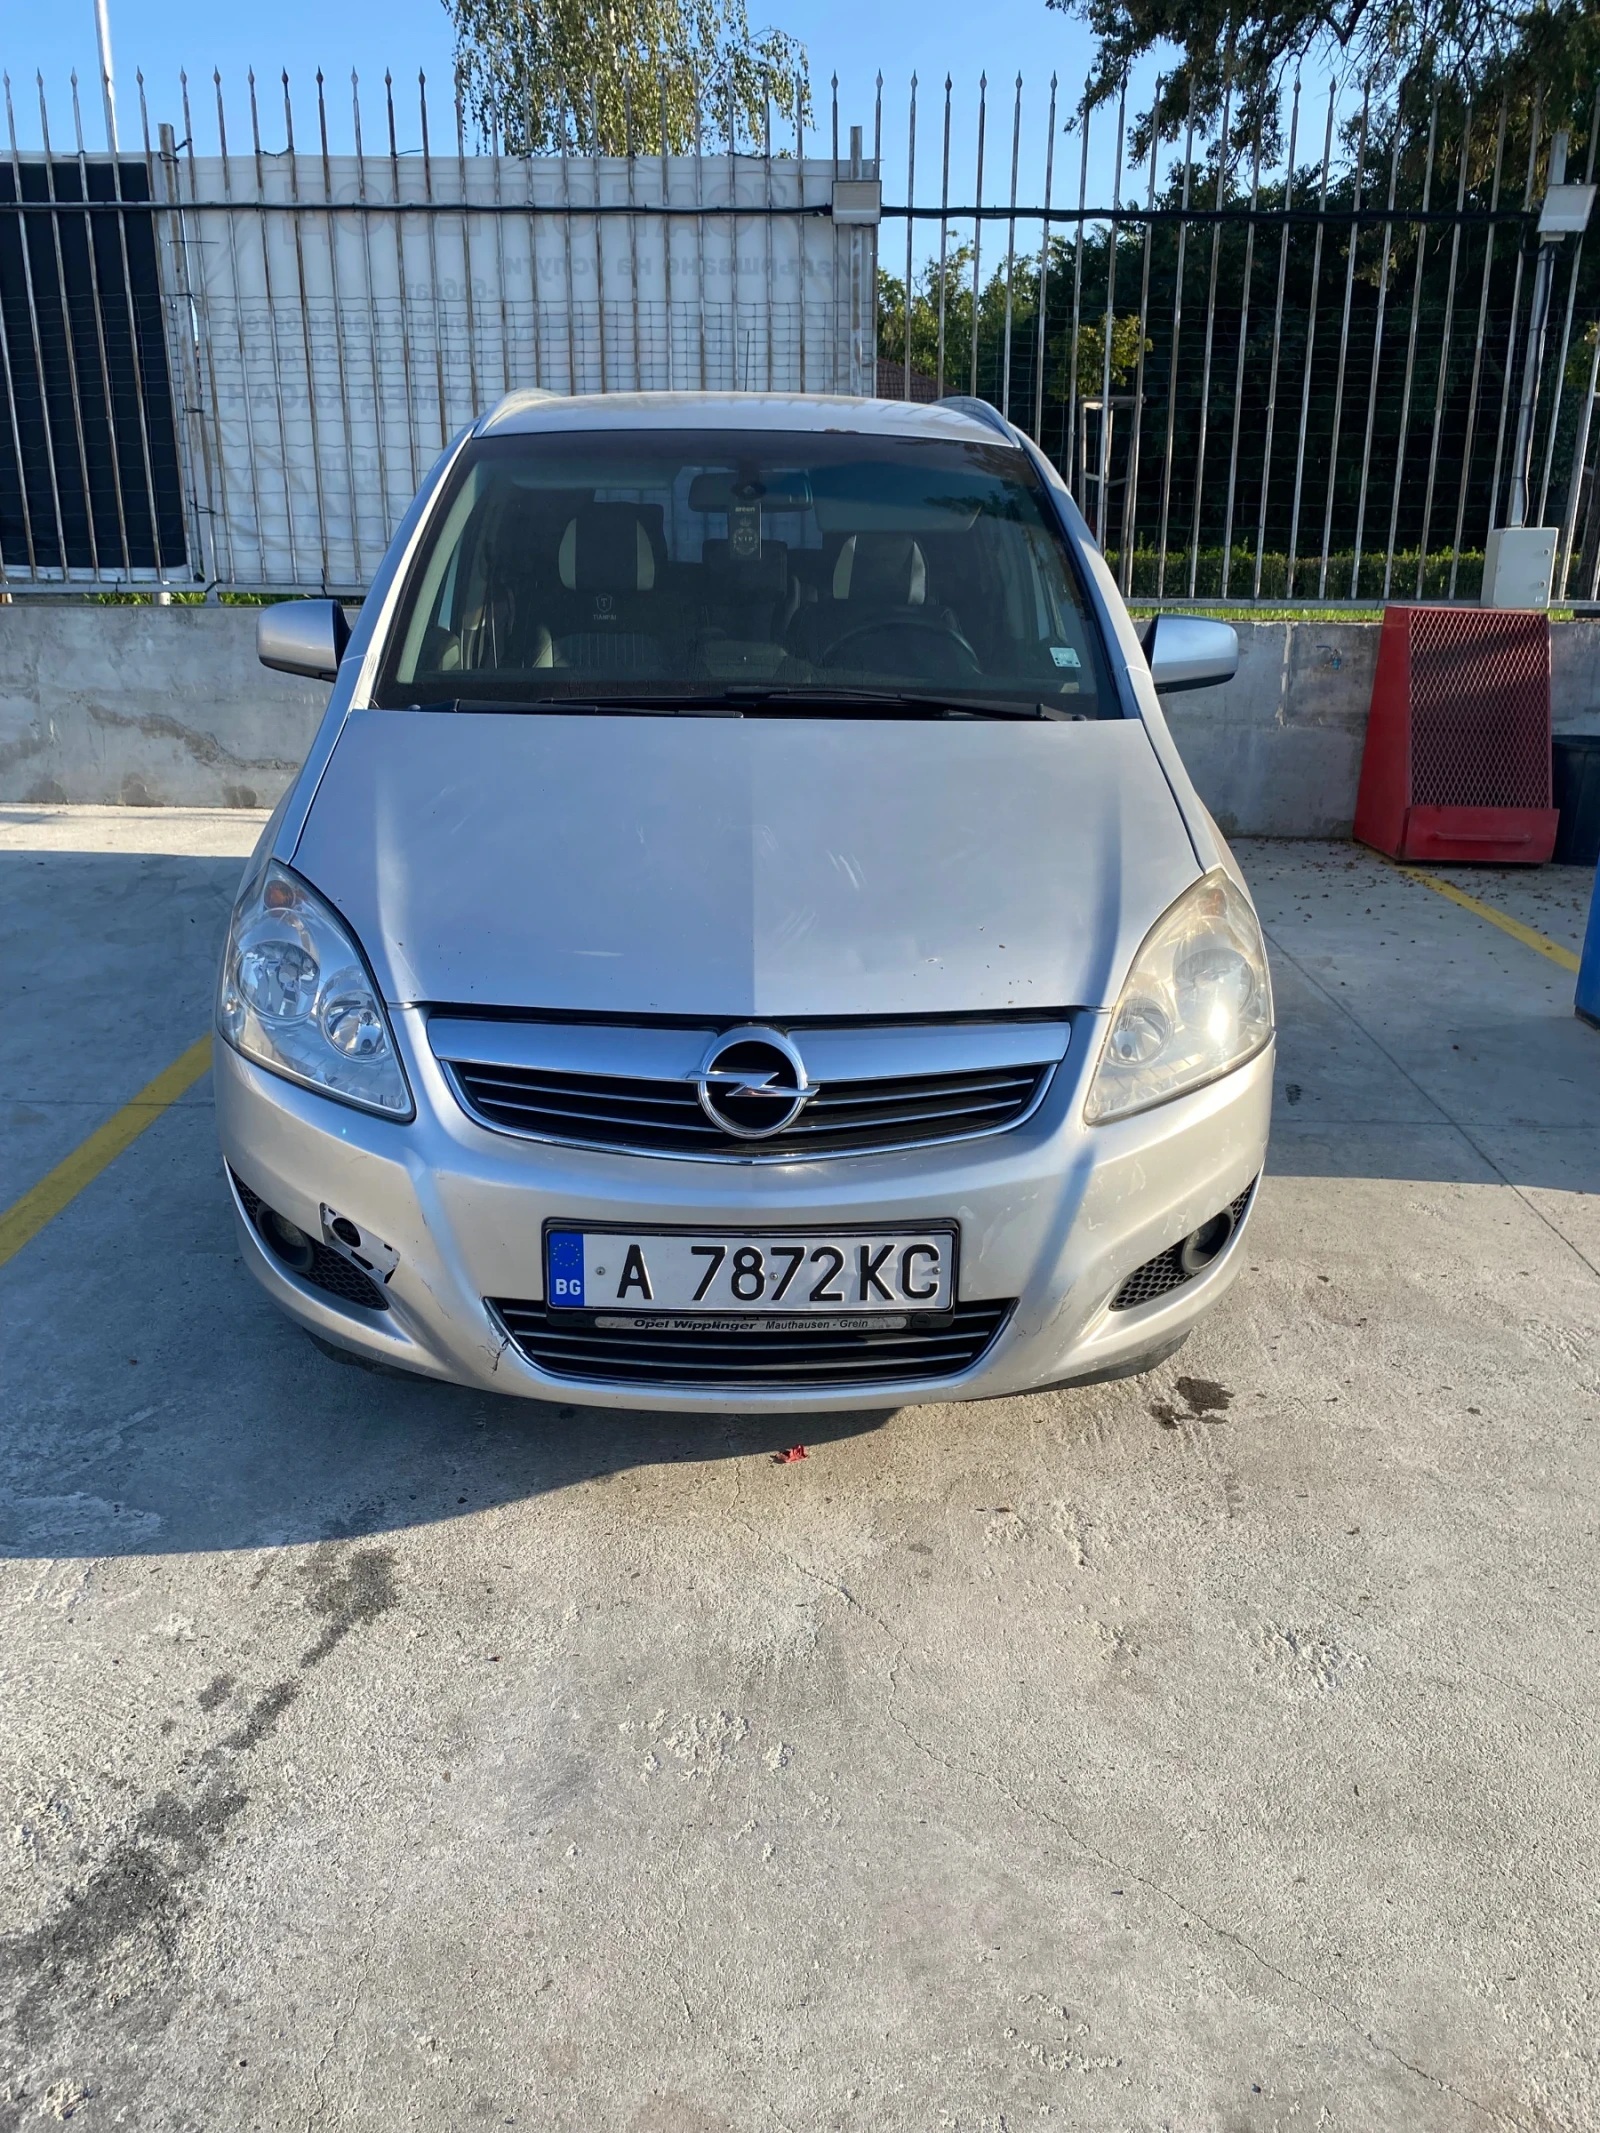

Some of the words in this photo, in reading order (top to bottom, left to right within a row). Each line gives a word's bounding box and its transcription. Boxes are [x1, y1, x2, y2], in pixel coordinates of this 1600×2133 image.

[556, 1278, 582, 1296] BG
[633, 1317, 670, 1330] Opel
[674, 1319, 757, 1332] Wipplinger
[765, 1319, 831, 1331] Mauthausen
[839, 1319, 869, 1330] Grein
